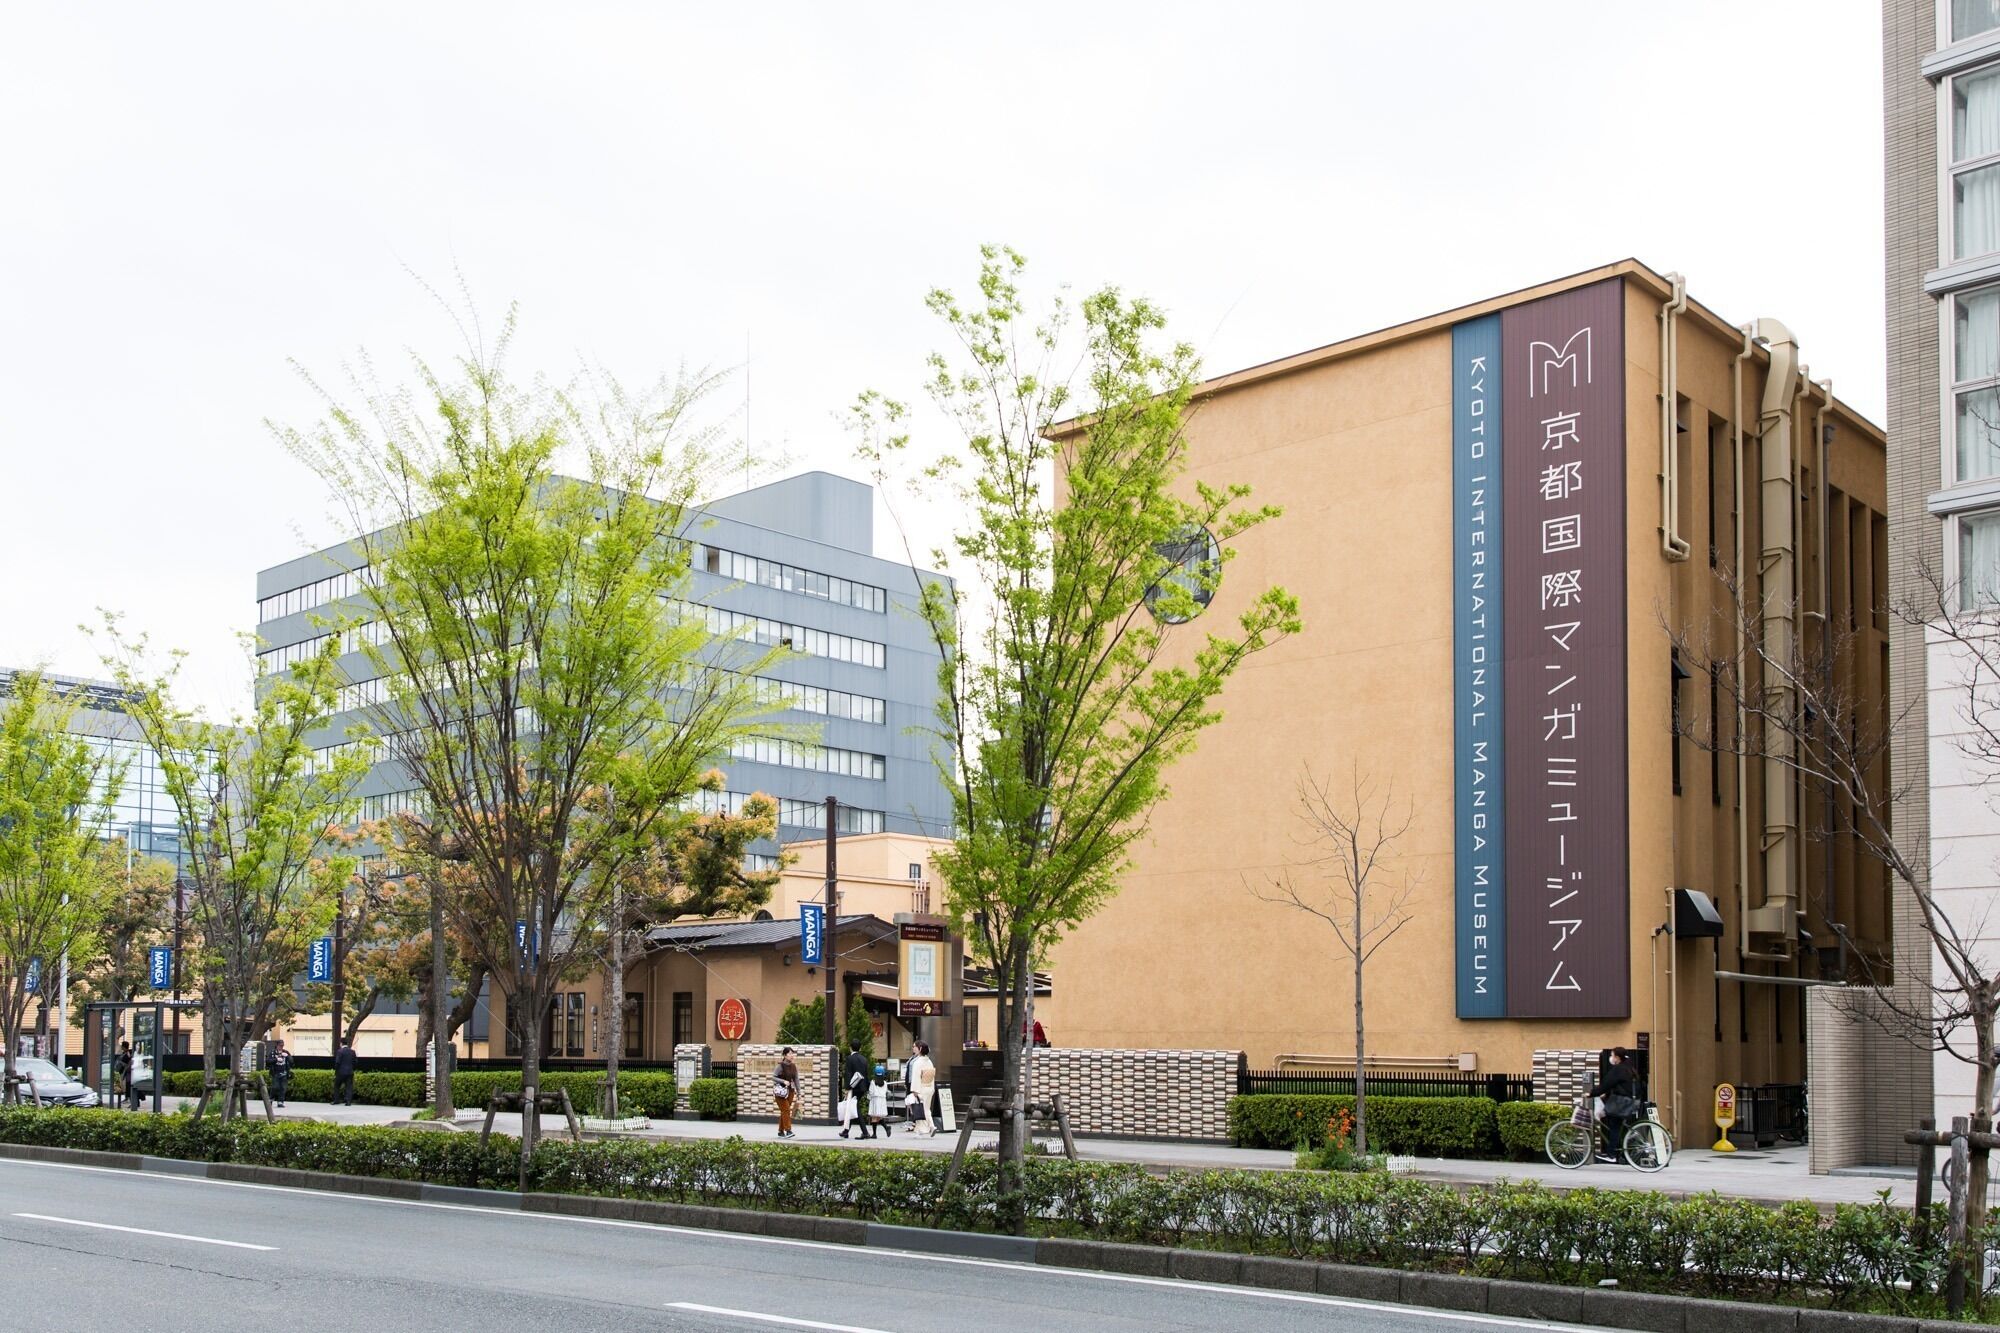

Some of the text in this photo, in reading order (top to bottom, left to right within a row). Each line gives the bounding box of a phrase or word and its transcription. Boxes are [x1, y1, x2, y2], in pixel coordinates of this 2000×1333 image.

[1470, 355, 1489, 994] KYOTO INTERNATIONAL MANGA MUSEUM
[1539, 410, 1583, 992] 京都国際マンガミュージアム
[804, 909, 816, 959] MANGA
[154, 951, 164, 985] MANGA
[312, 941, 324, 979] MANGA
